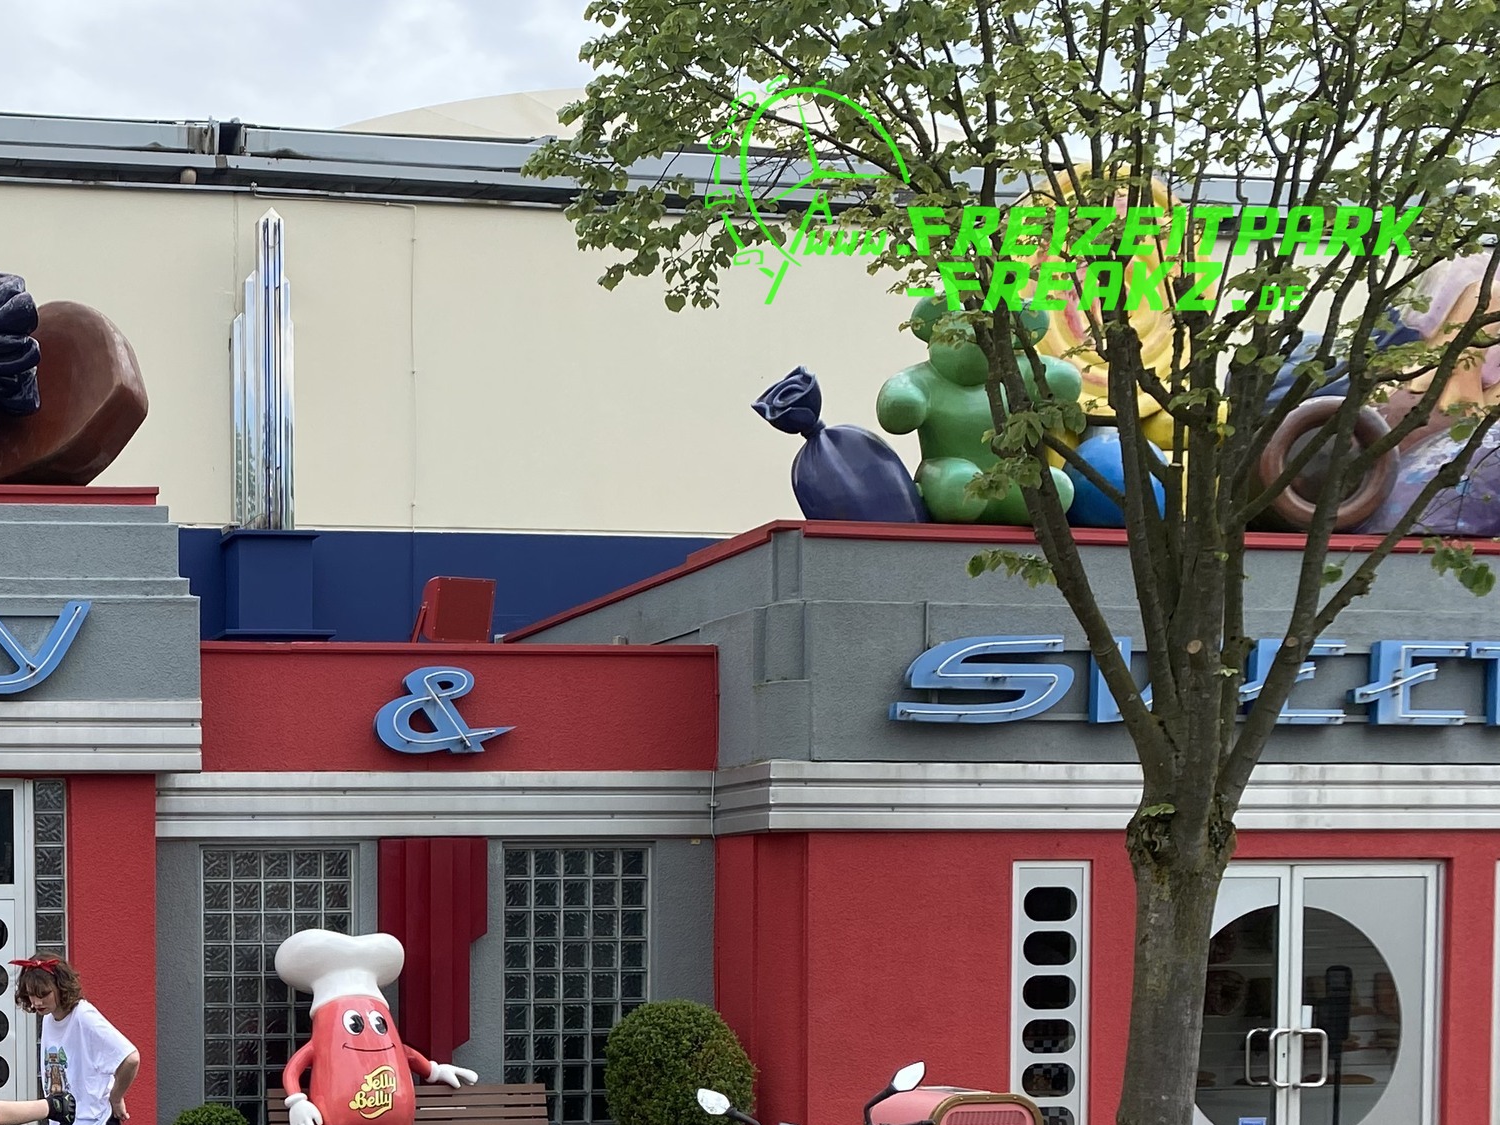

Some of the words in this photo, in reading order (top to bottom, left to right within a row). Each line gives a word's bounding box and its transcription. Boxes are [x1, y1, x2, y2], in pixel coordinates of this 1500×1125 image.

[373, 666, 518, 755] &
[361, 1065, 397, 1093] Jelly
[348, 1090, 393, 1115] Belly
